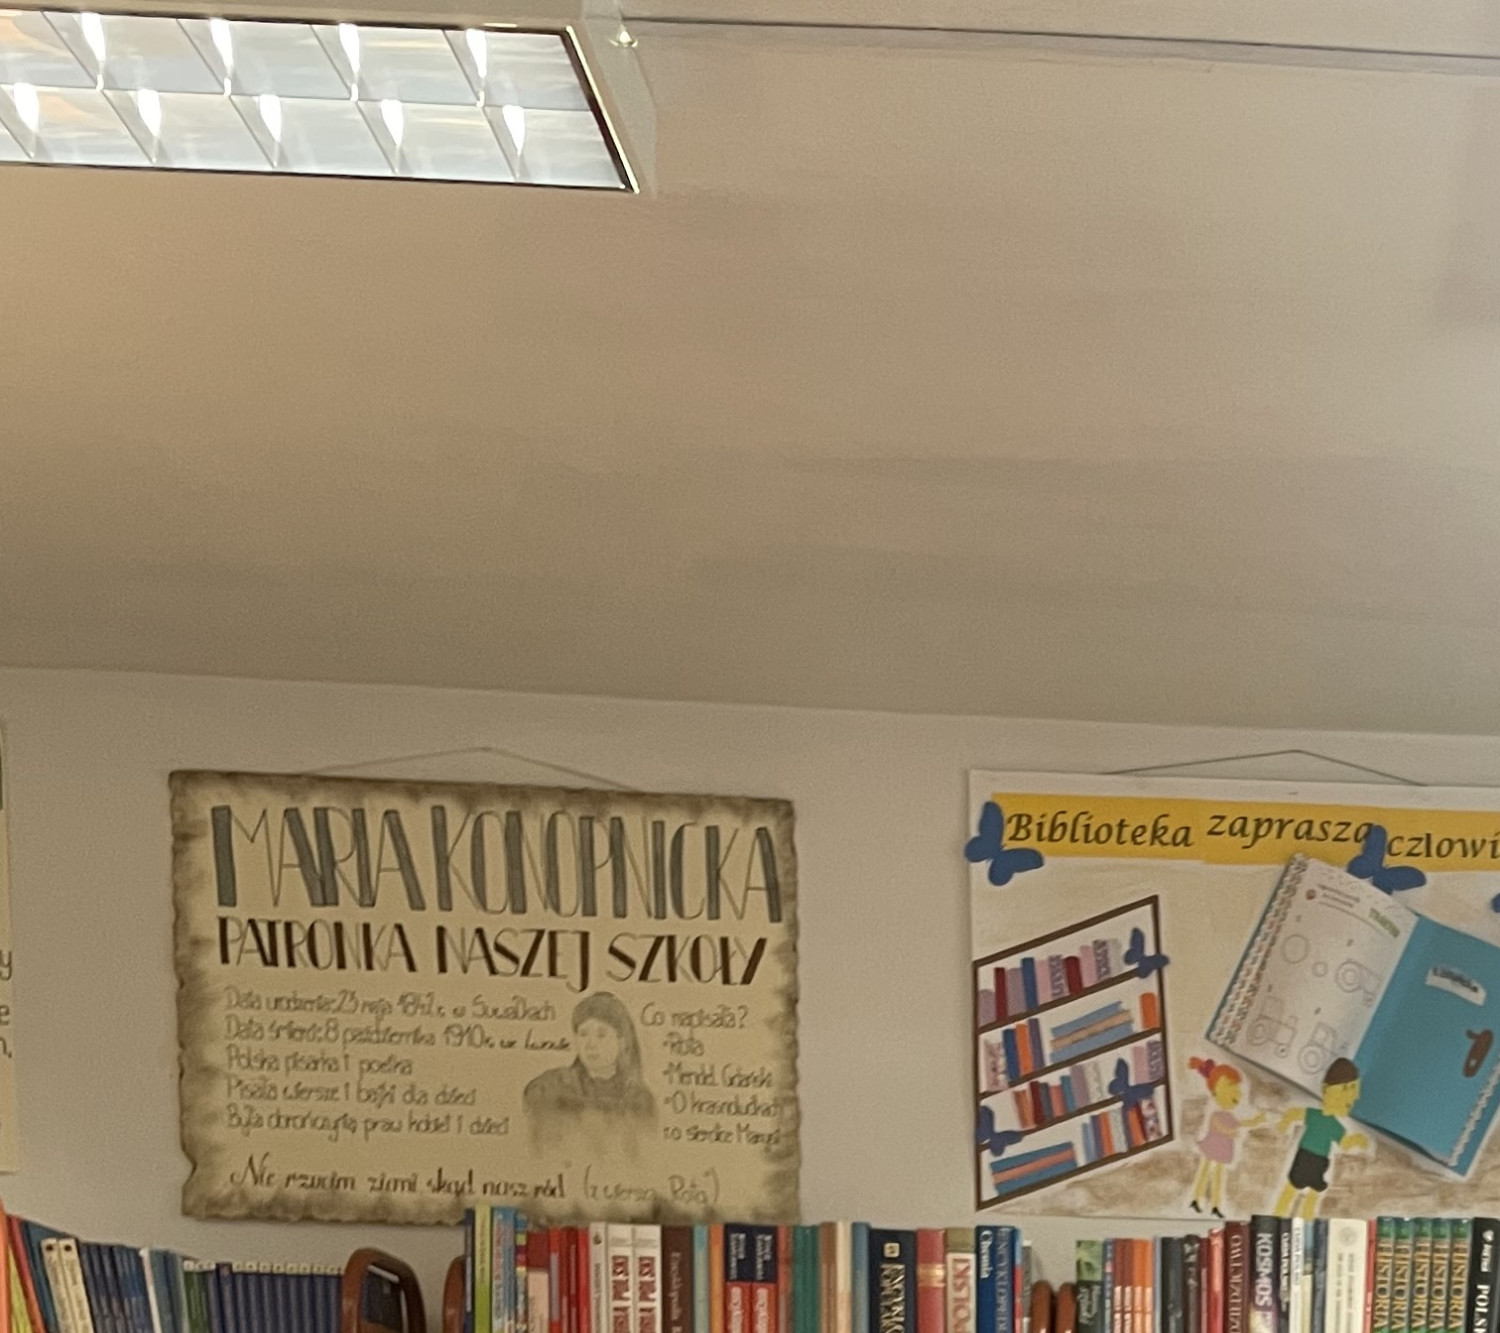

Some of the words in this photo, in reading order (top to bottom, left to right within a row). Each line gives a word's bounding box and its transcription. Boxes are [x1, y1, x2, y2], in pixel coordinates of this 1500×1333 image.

[210, 805, 426, 912] MARIA
[430, 805, 783, 924] KONOPNICKA
[1005, 812, 1195, 848] Biblioteka
[1207, 813, 1374, 847] zaprasza
[217, 915, 417, 974] PATRONKA
[435, 924, 592, 994] NASZEJ
[605, 928, 769, 987] SZKOŁY
[979, 1230, 993, 1279] Chemia
[1255, 1232, 1273, 1307] KOSMOS
[1374, 1243, 1393, 1328] HISTORIA
[1391, 1243, 1411, 1330] HISTORIA
[1410, 1241, 1431, 1328] HISTORIA
[1429, 1241, 1450, 1330] HISTORIA
[1447, 1242, 1469, 1330] HISTORIA
